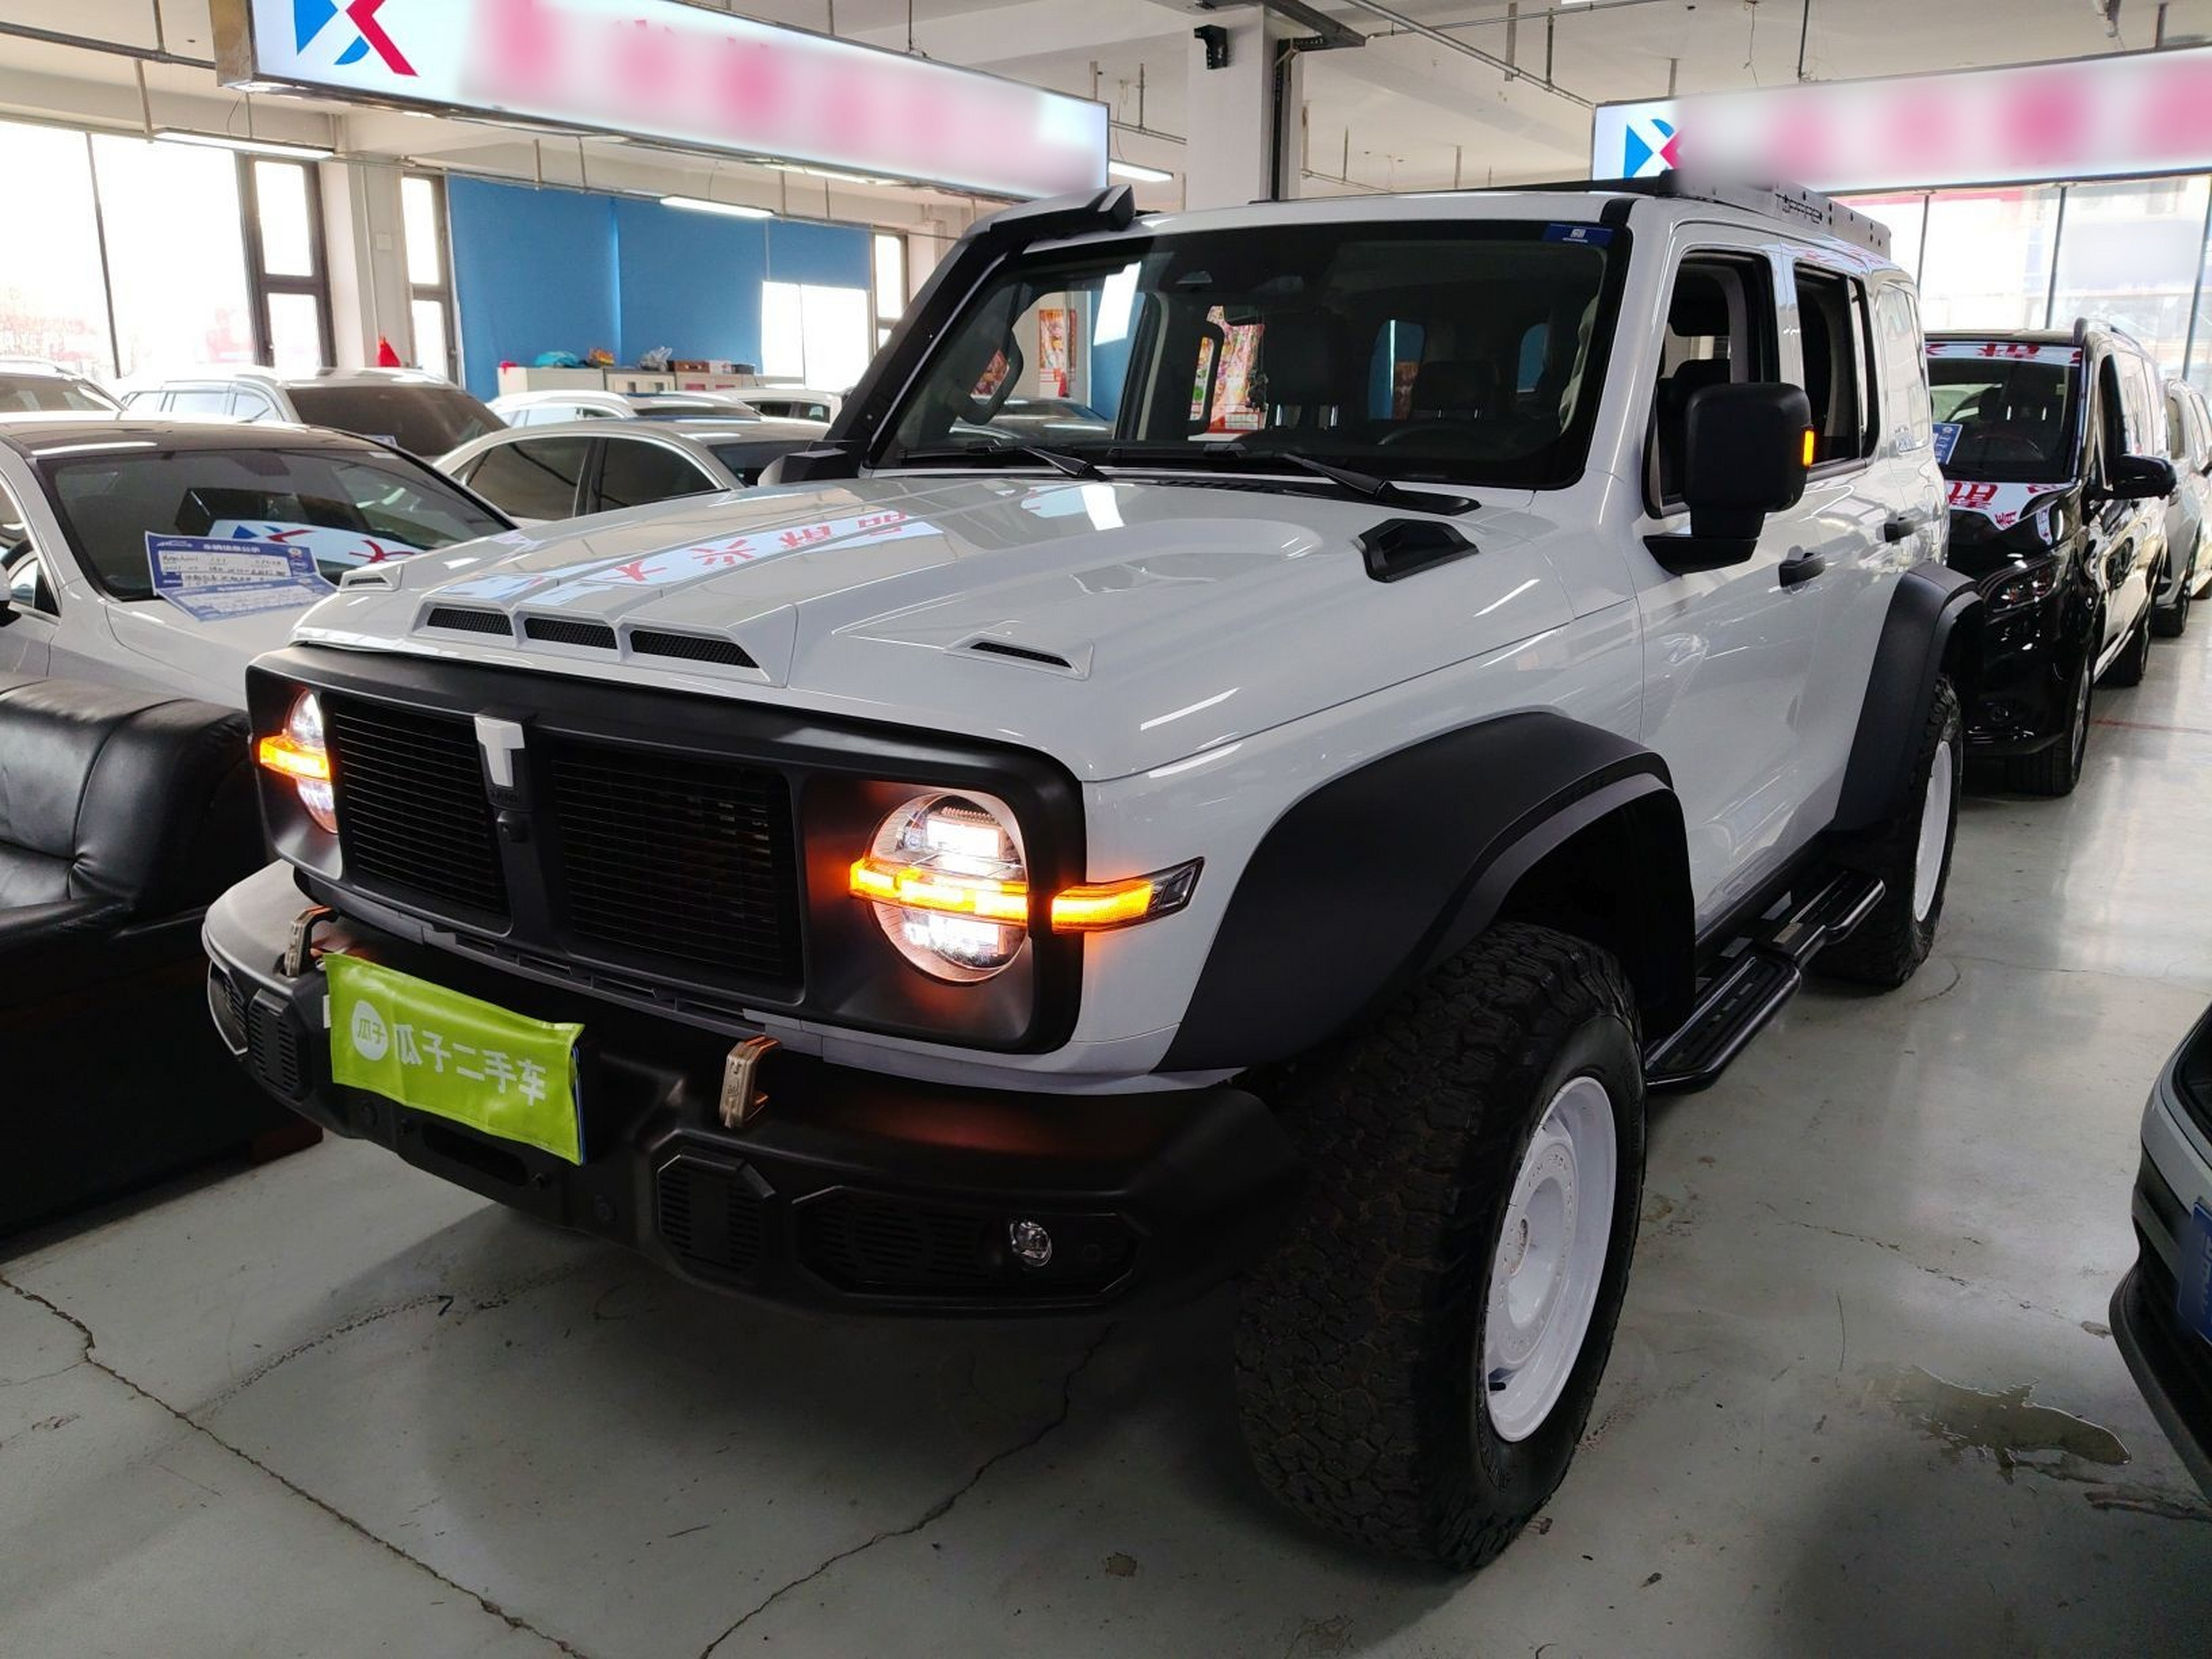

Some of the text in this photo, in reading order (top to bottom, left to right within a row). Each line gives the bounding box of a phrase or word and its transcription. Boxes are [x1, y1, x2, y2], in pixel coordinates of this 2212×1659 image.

[357, 1018, 384, 1044] 瓜子
[393, 1024, 546, 1106] 瓜子二手车
